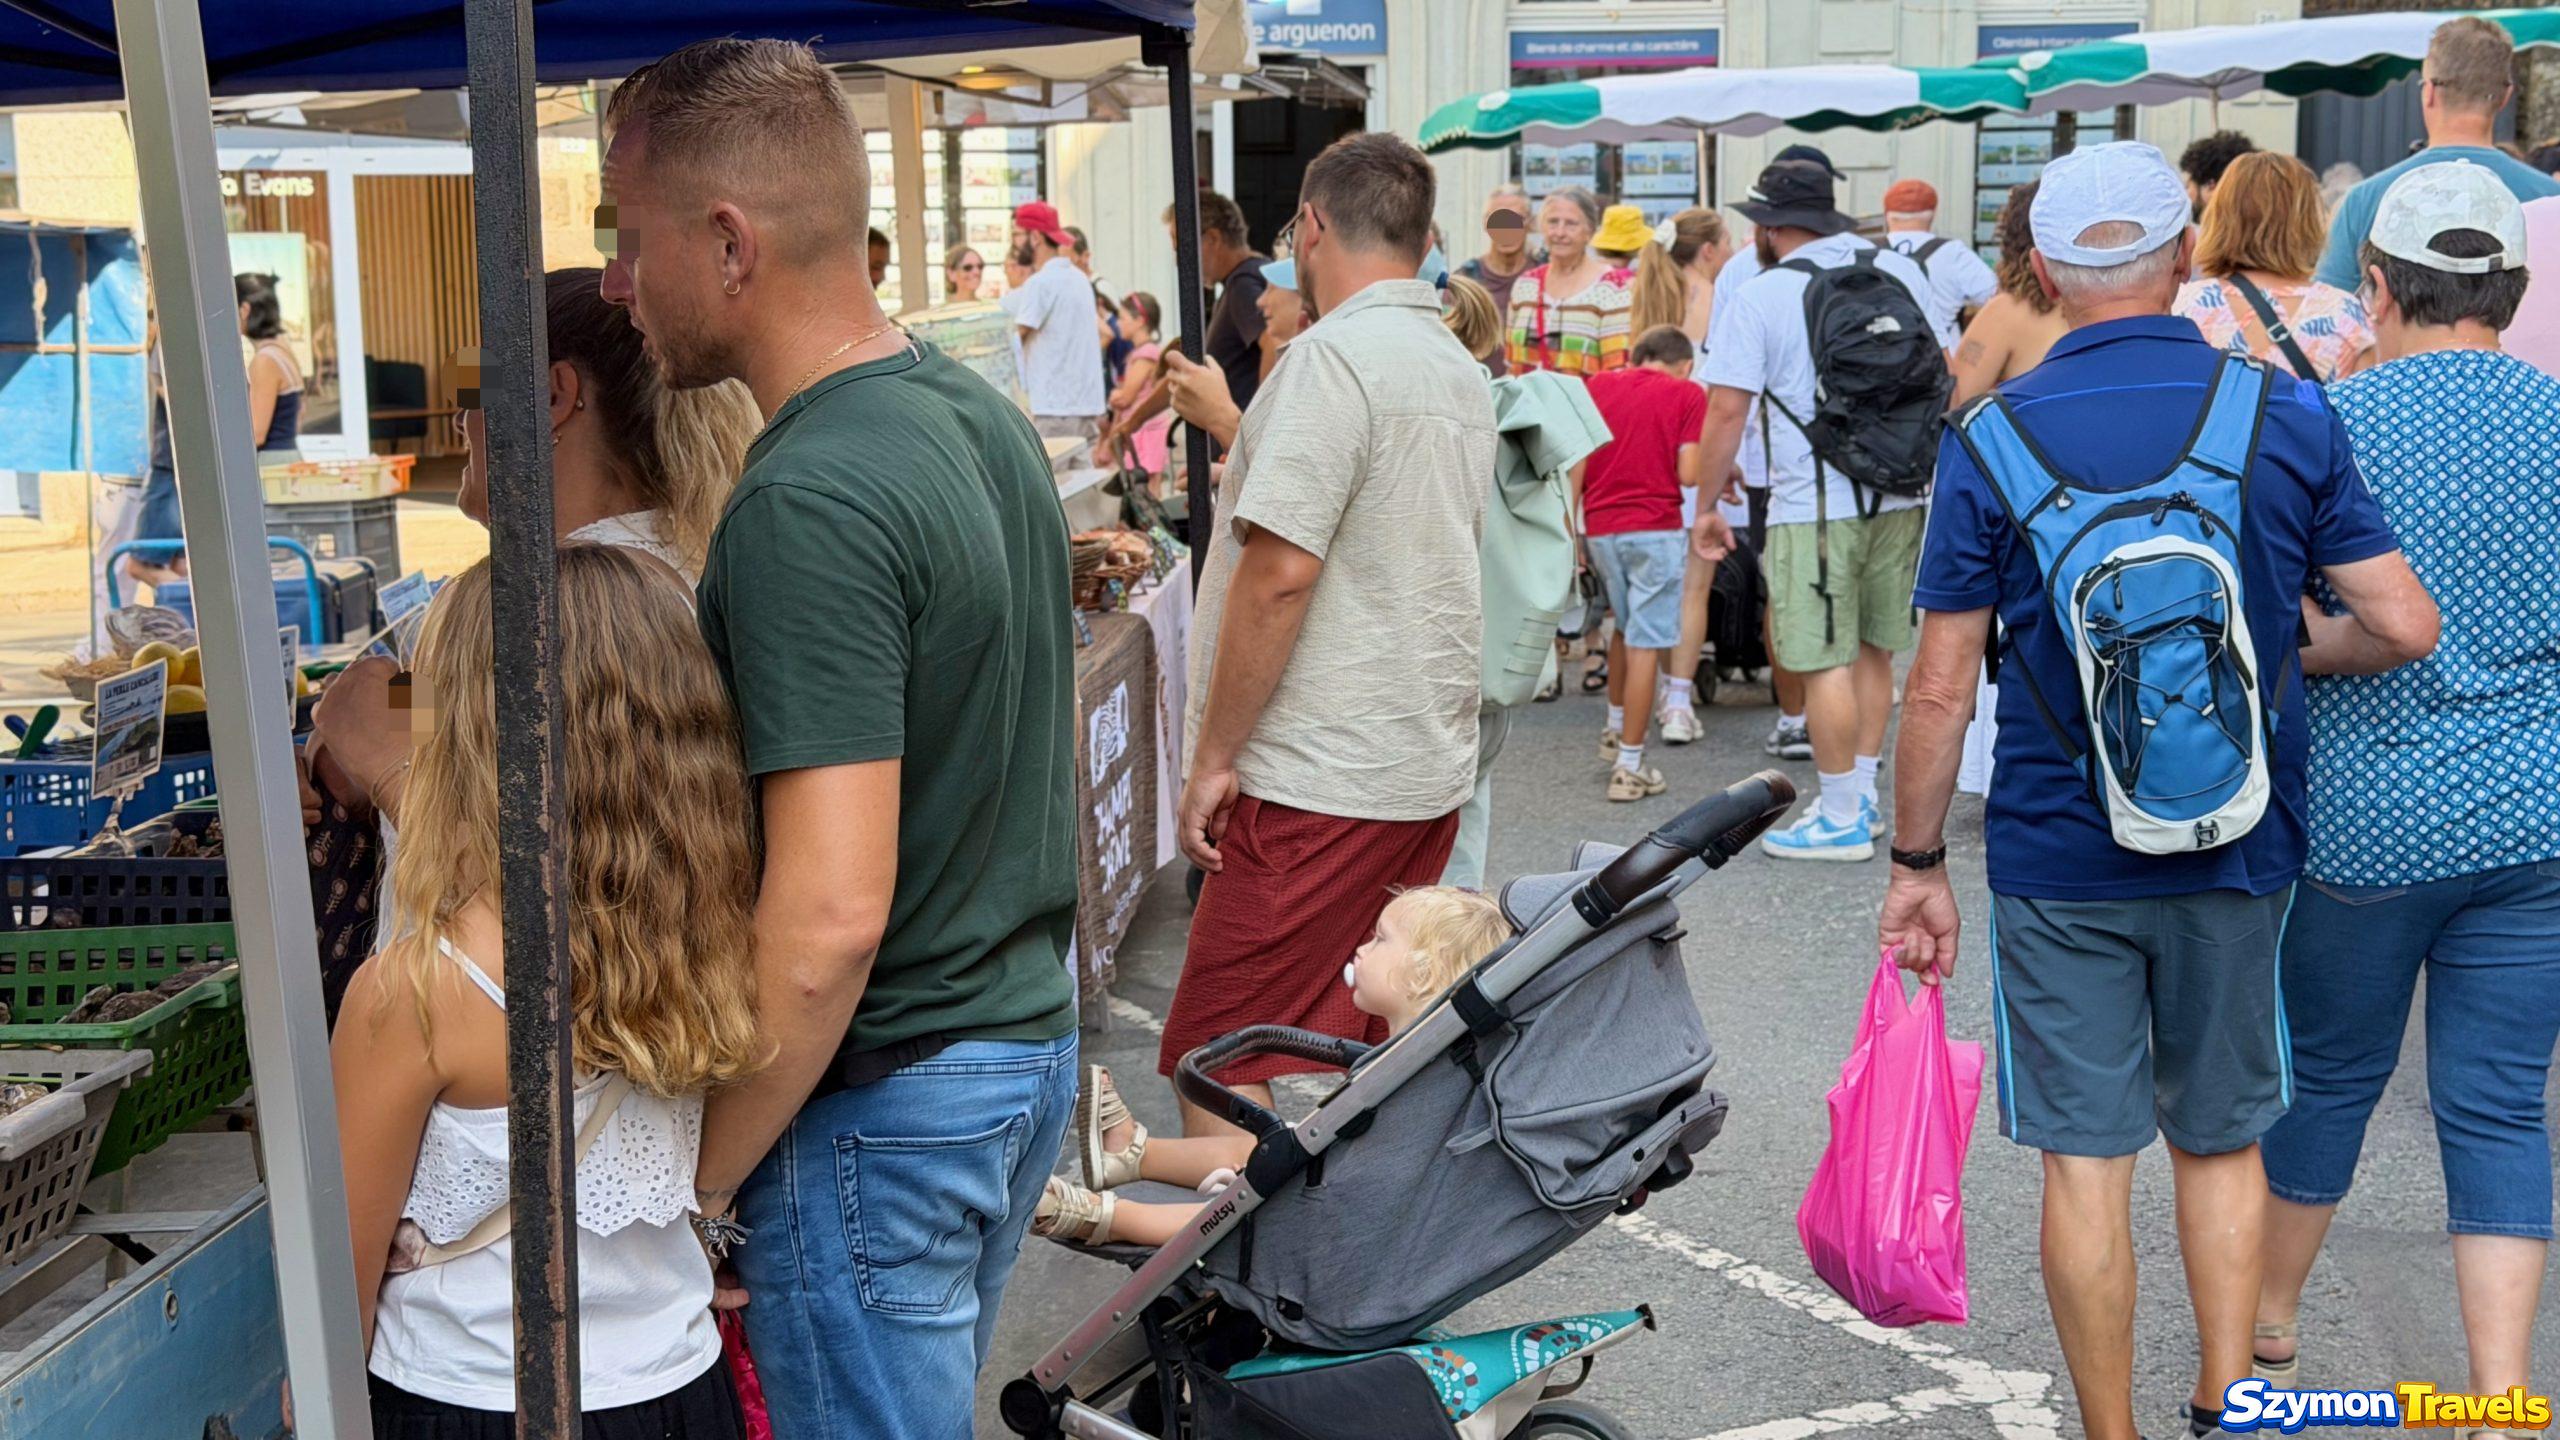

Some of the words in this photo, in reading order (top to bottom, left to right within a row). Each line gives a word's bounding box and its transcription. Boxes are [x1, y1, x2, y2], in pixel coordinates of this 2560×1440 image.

[1251, 26, 1266, 42] e
[1269, 23, 1376, 47] arguenon
[1526, 43, 1556, 54] Biens
[1559, 42, 1573, 54] de
[1575, 42, 1615, 53] charme
[1647, 39, 1699, 51] caractère
[244, 173, 315, 197] Evans
[1200, 1200, 1236, 1236] mutsy
